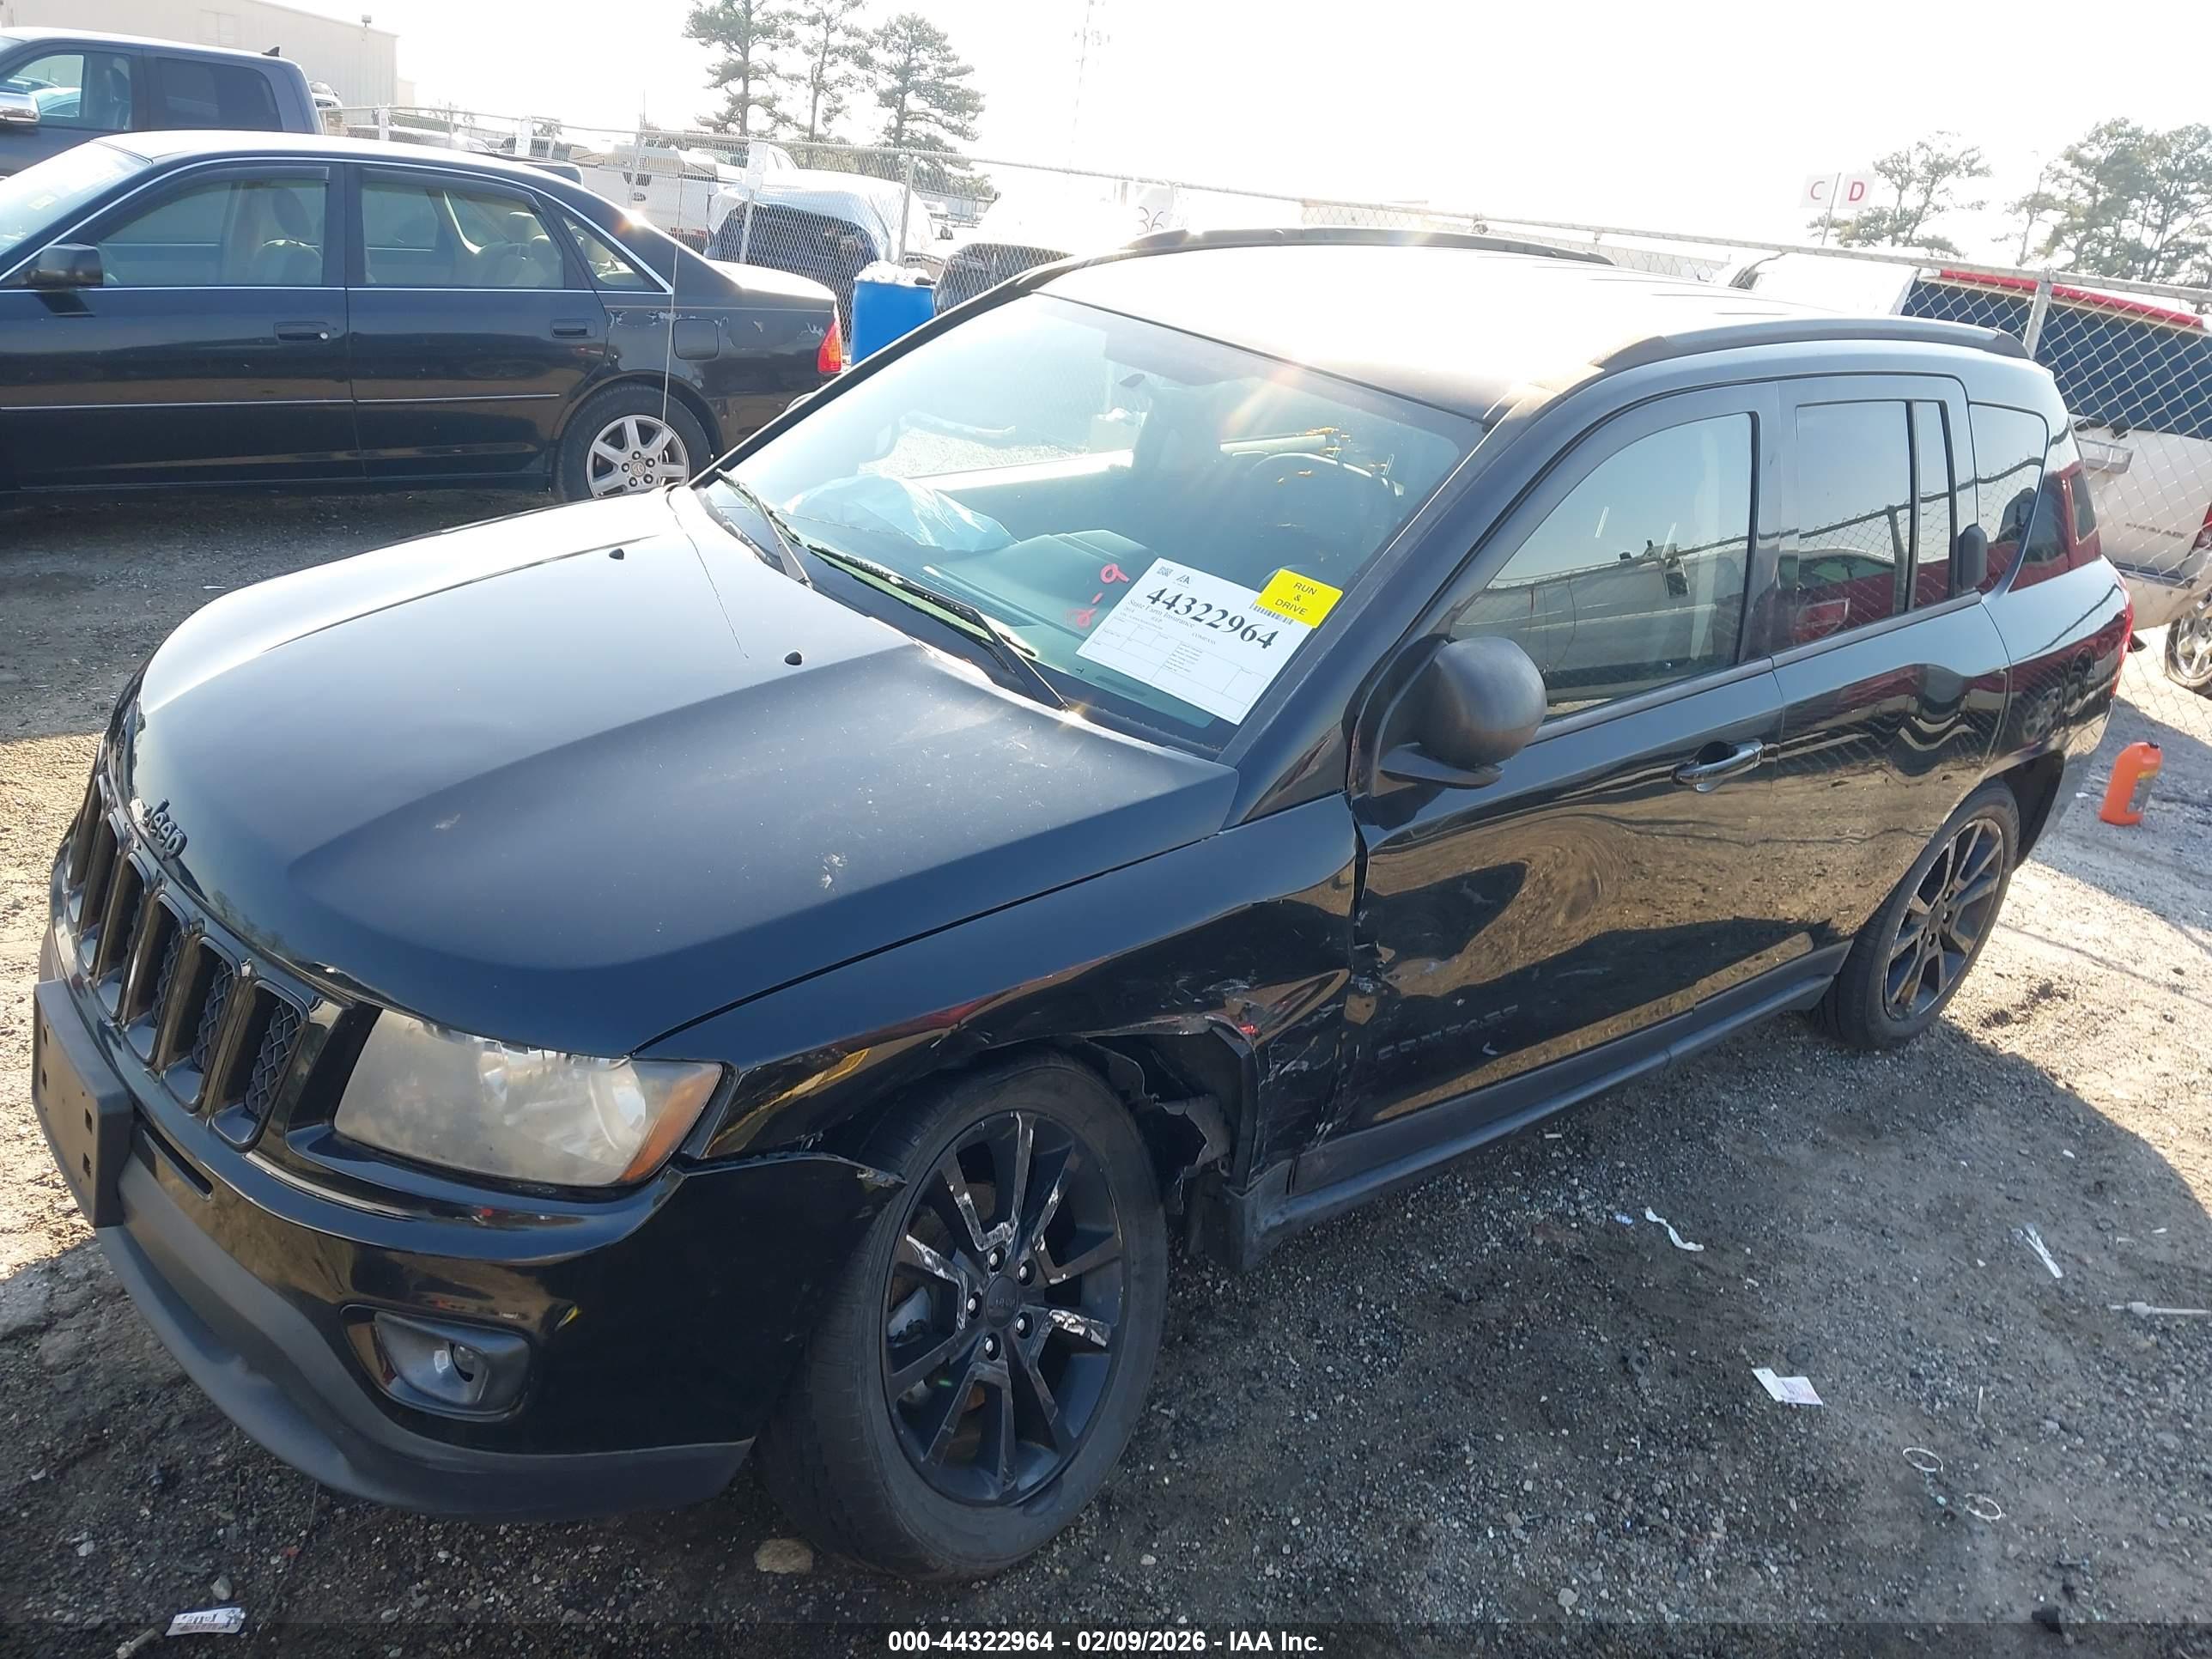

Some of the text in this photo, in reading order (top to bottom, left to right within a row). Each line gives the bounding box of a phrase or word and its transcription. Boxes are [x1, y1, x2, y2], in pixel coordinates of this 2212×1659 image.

[1810, 180, 1865, 202] C D
[1293, 581, 1318, 596] RUN
[1293, 593, 1303, 602] &
[1128, 599, 1146, 609] State
[1145, 603, 1163, 616] Farm
[1163, 611, 1195, 629] Insurance
[1146, 587, 1279, 649] 44322964
[1274, 598, 1309, 617] DRIVE
[143, 797, 188, 861] Jeep
